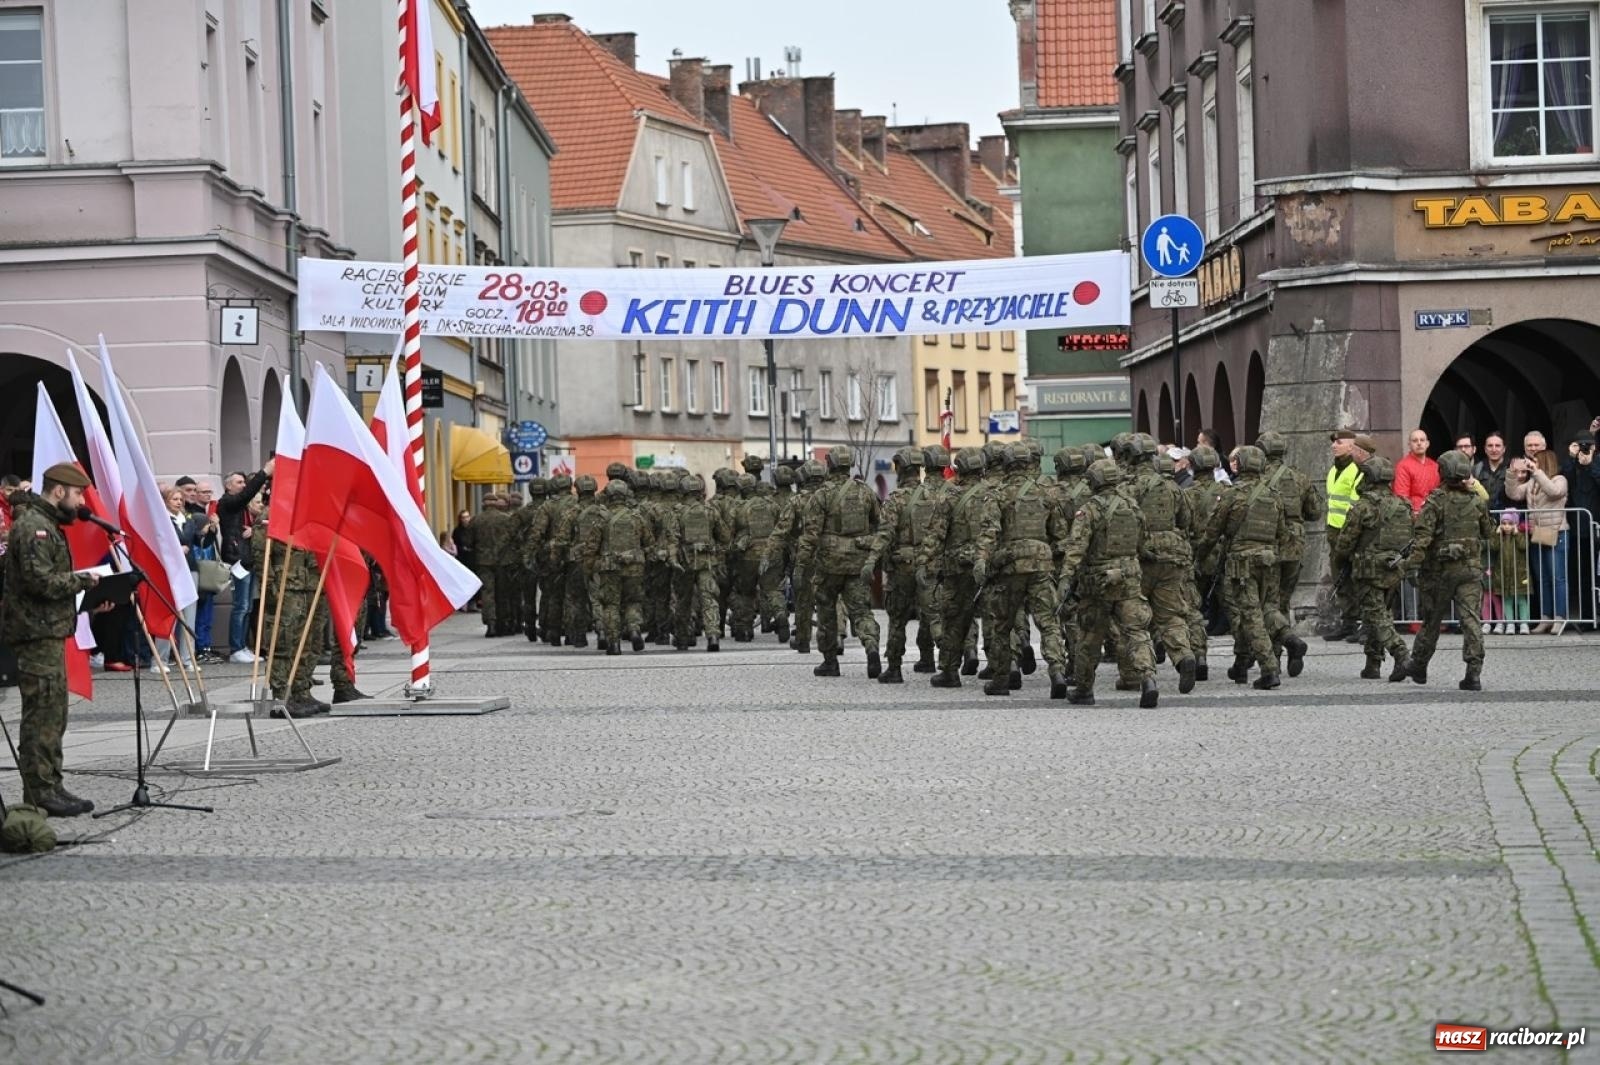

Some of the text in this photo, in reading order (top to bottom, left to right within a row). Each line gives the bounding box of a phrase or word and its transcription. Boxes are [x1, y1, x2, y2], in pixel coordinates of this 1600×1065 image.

[723, 271, 966, 296] BLUES KONCERT
[1167, 281, 1196, 289] dotyczy
[360, 297, 444, 312] KULTRY
[465, 308, 508, 320] GODZ.
[621, 292, 1069, 335] KEITH DUNN & PRZYJACIELE
[1419, 313, 1466, 326] RYNEK
[320, 315, 346, 328] SALA
[577, 325, 594, 337] 38
[1043, 391, 1116, 405] RISTORANTE
